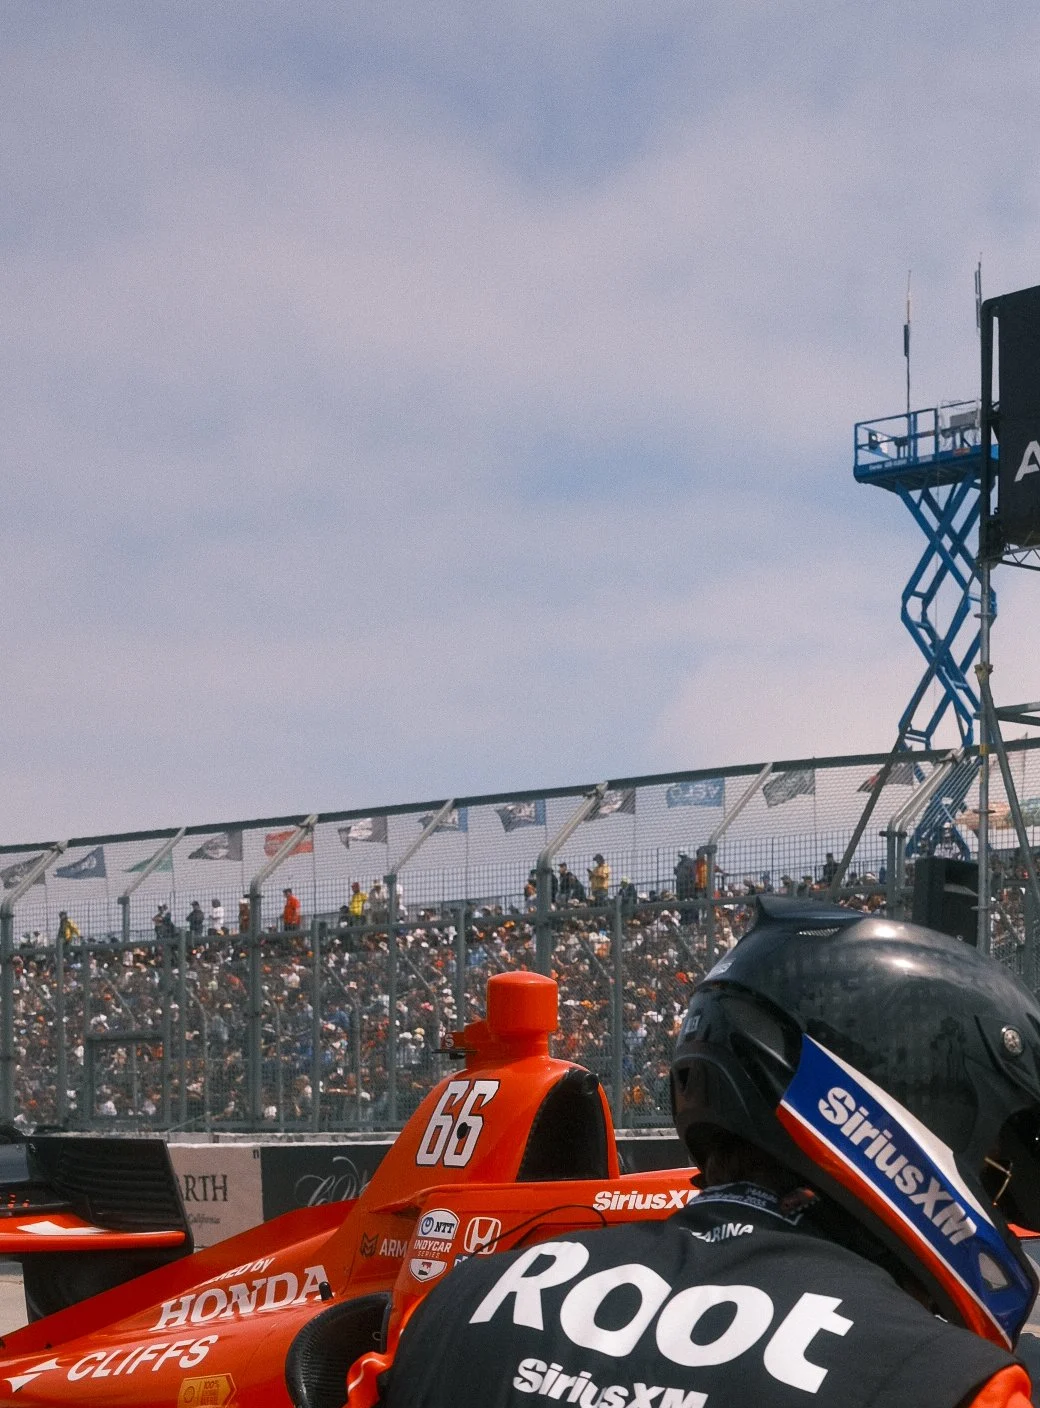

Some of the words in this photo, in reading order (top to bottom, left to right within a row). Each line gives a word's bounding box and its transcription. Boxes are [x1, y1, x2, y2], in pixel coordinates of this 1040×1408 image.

[416, 1079, 500, 1168] 66
[183, 1174, 228, 1202] RTH
[818, 1087, 977, 1245] SiriusXM
[379, 1238, 407, 1258] ARM
[434, 1221, 455, 1234] NTT
[148, 1264, 335, 1332] HONDA
[67, 1335, 219, 1381] CLIFFS
